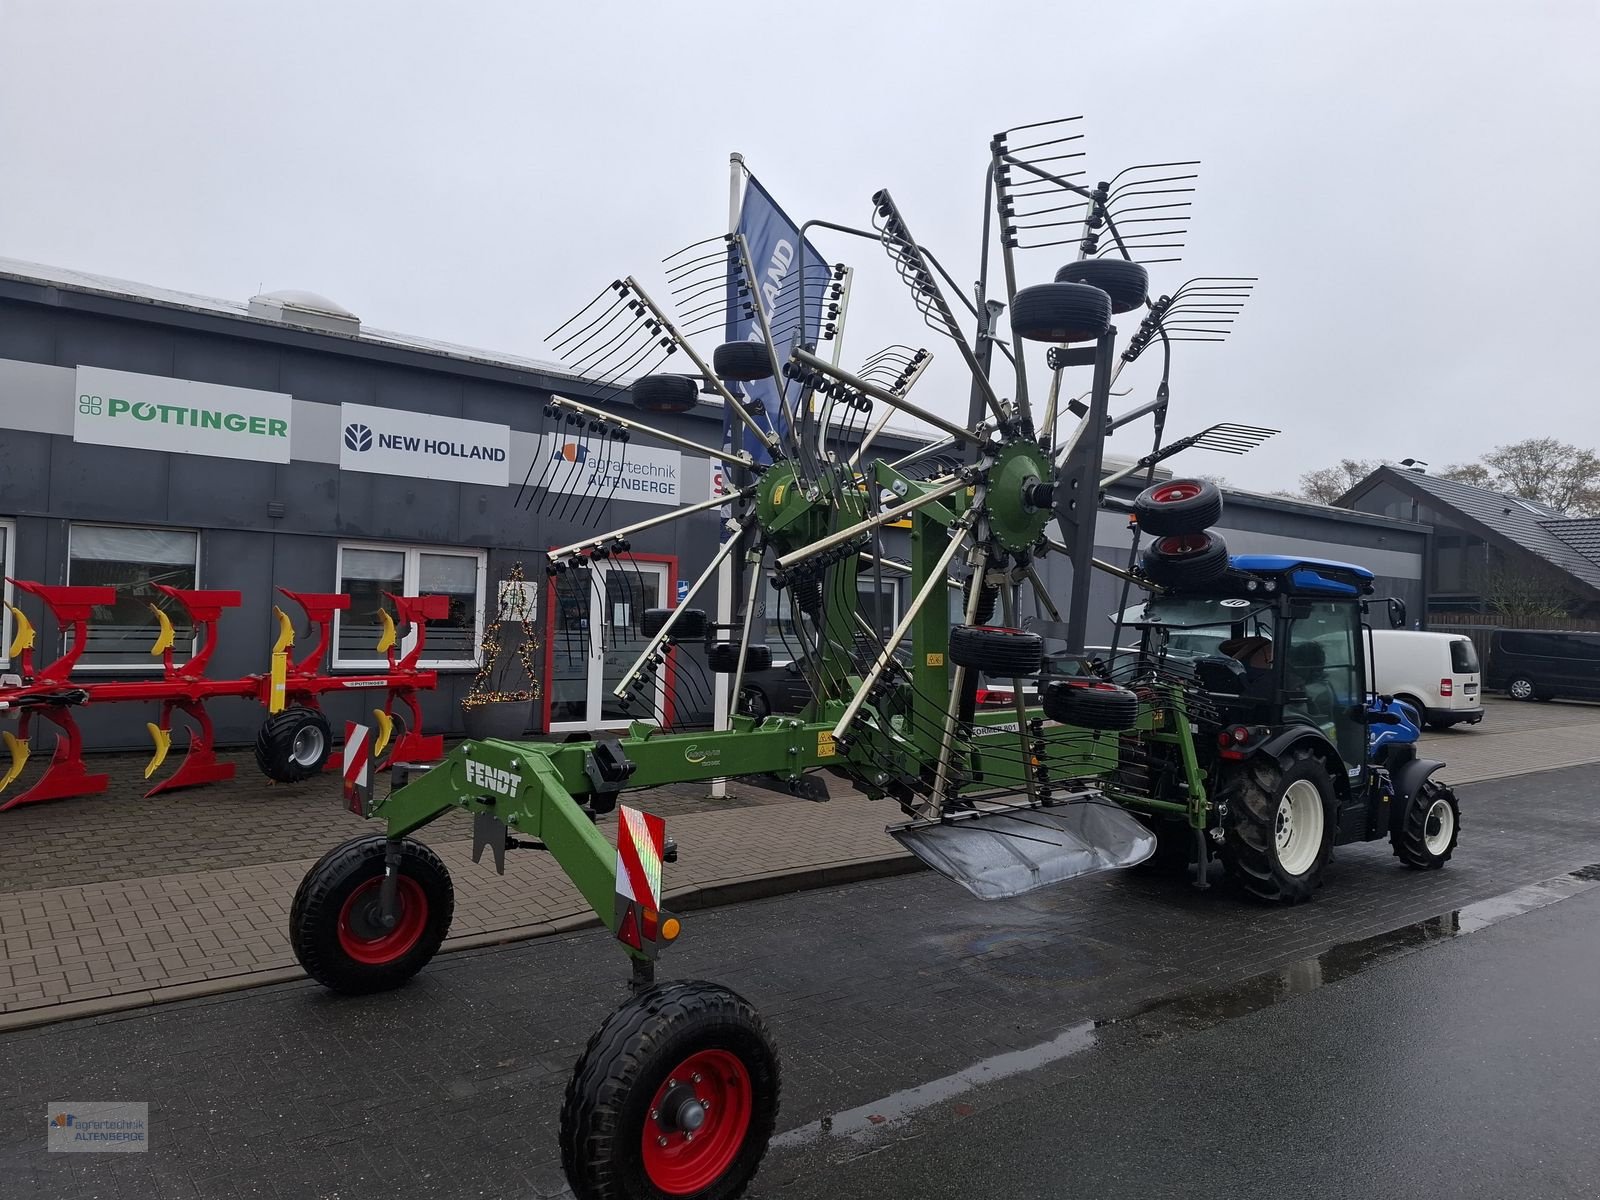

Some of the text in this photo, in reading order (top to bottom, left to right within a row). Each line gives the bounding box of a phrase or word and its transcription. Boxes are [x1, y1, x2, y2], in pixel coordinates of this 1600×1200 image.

[378, 433, 506, 462] NEW HOLLAND
[588, 457, 676, 479] agrartechnik
[587, 473, 676, 495] ALTENBERGE
[466, 759, 522, 798] FENDT
